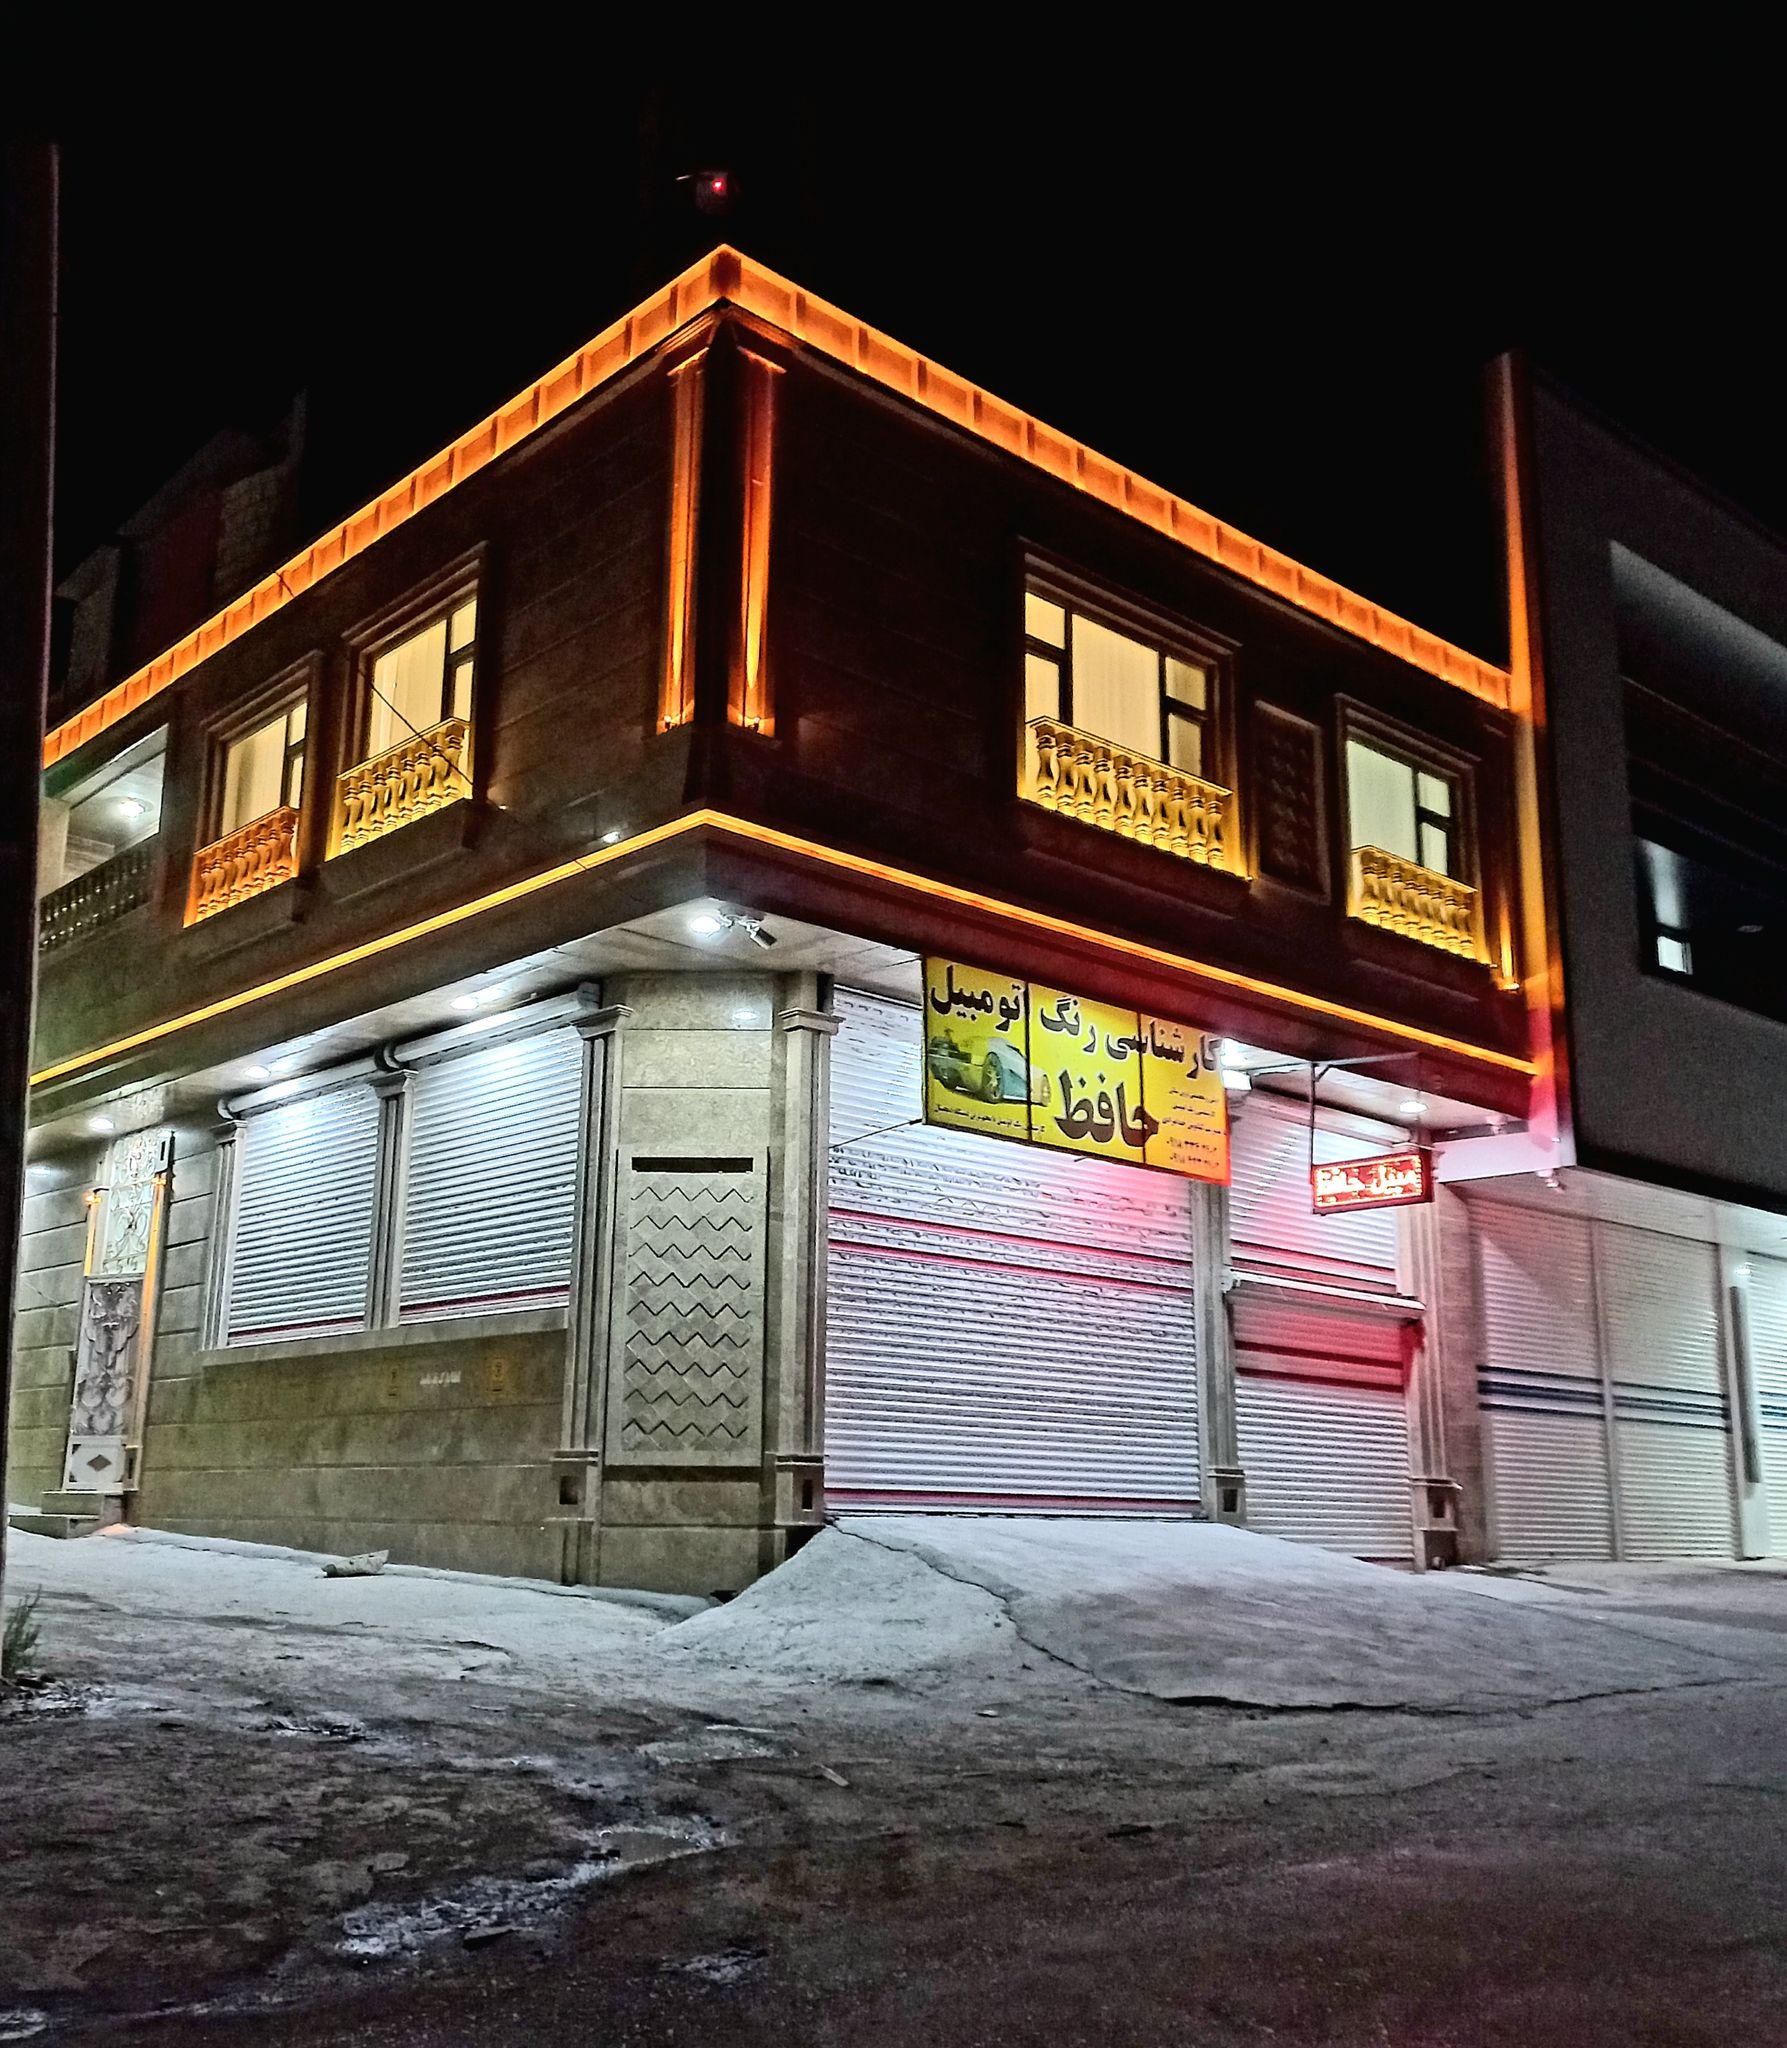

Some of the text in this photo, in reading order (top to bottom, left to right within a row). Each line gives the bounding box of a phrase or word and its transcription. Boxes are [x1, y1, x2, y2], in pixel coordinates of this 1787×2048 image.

[930, 963, 1029, 1033] تومبیل
[1041, 998, 1098, 1054] رنگ
[1055, 1070, 1161, 1150] حافظ
